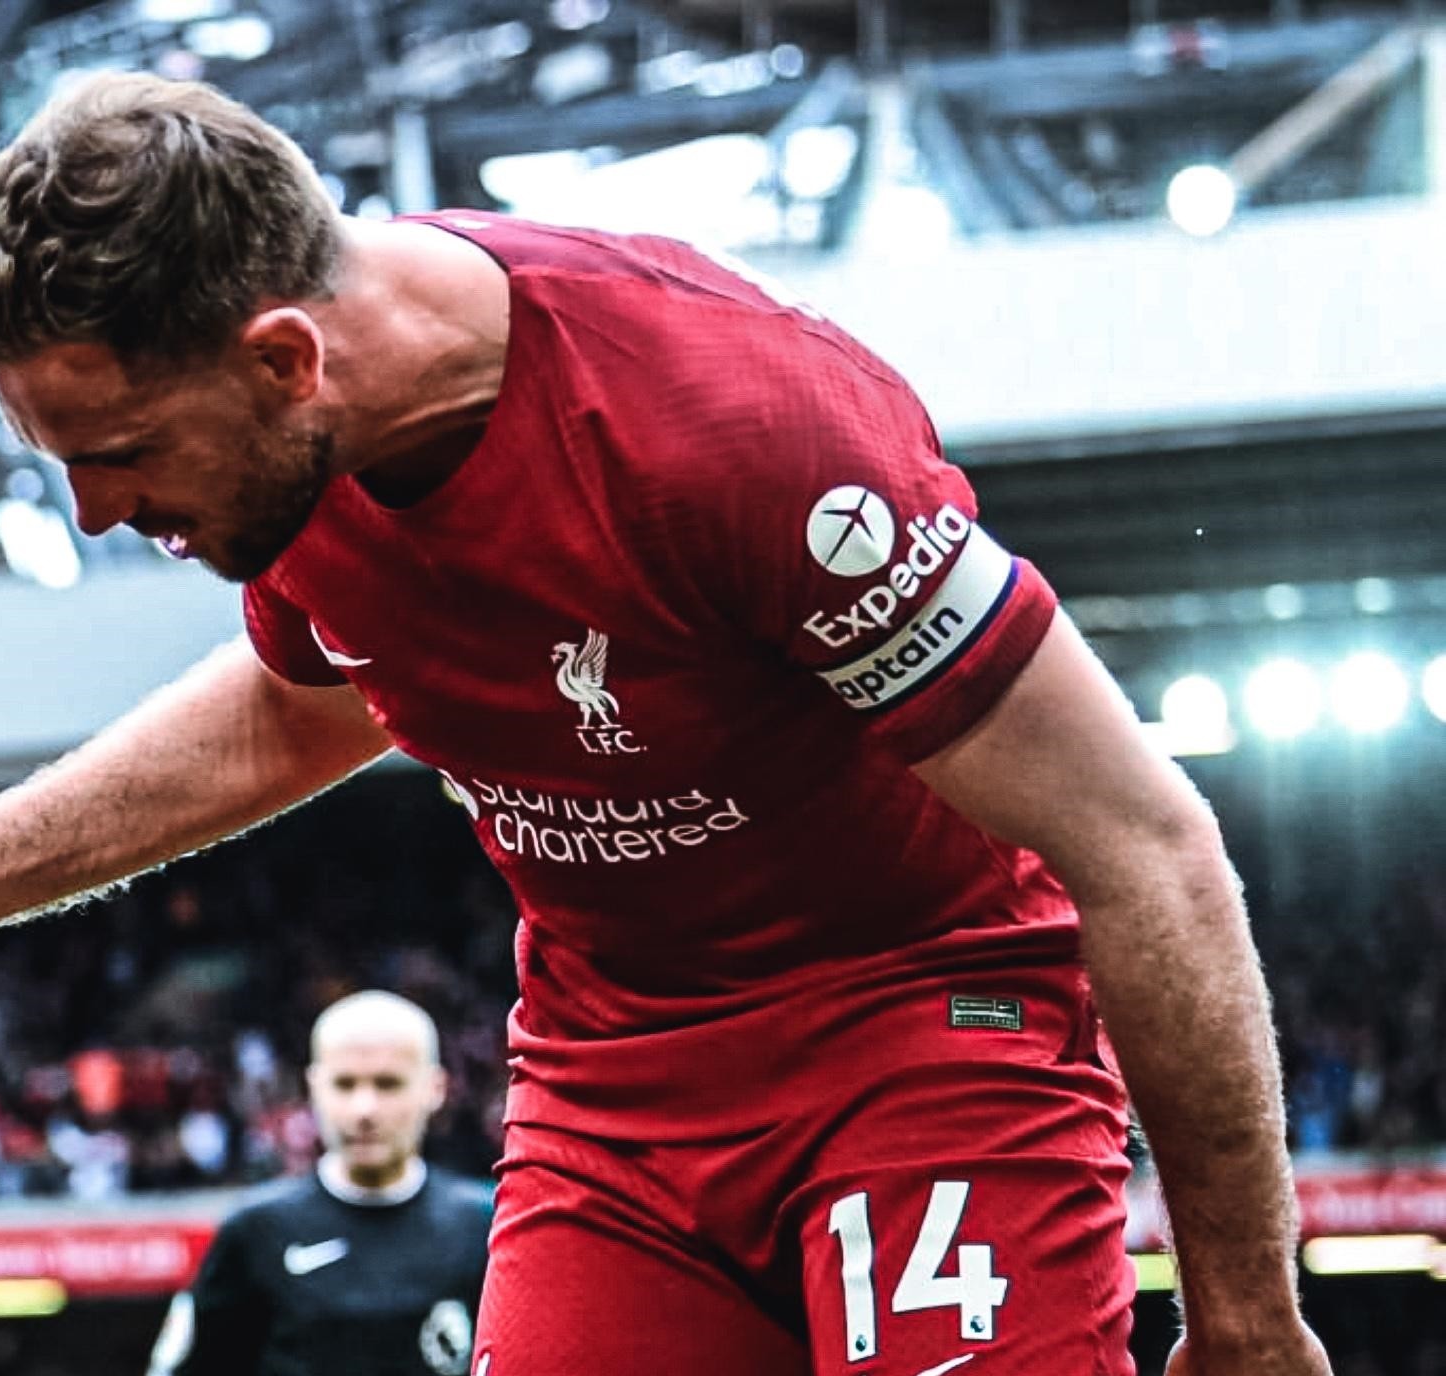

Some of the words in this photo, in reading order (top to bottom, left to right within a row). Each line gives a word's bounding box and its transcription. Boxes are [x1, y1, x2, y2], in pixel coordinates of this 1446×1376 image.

[803, 503, 972, 649] Expedia
[835, 607, 965, 704] aptain
[495, 798, 751, 864] chartered
[827, 1181, 1008, 1362] 14
